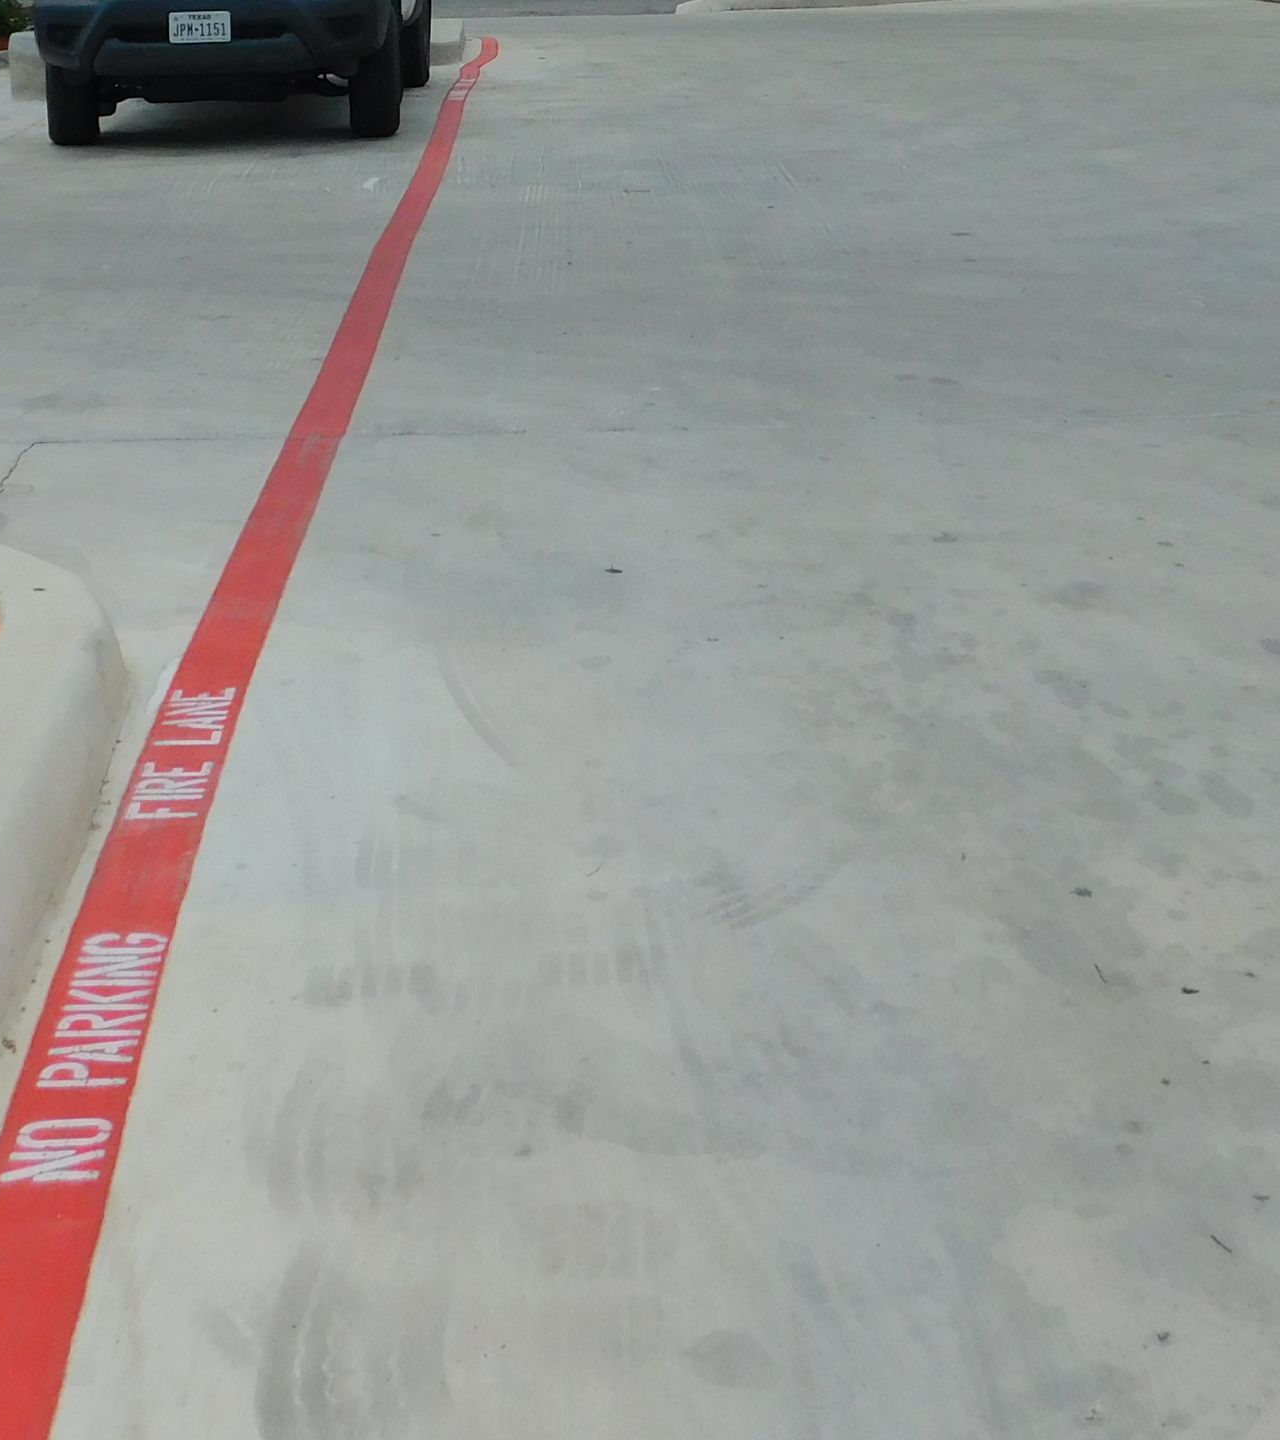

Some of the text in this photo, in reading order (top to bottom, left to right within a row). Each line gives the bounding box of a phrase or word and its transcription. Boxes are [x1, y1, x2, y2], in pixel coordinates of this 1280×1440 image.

[124, 687, 236, 822] FIRE LANE
[36, 931, 169, 1089] PARKING
